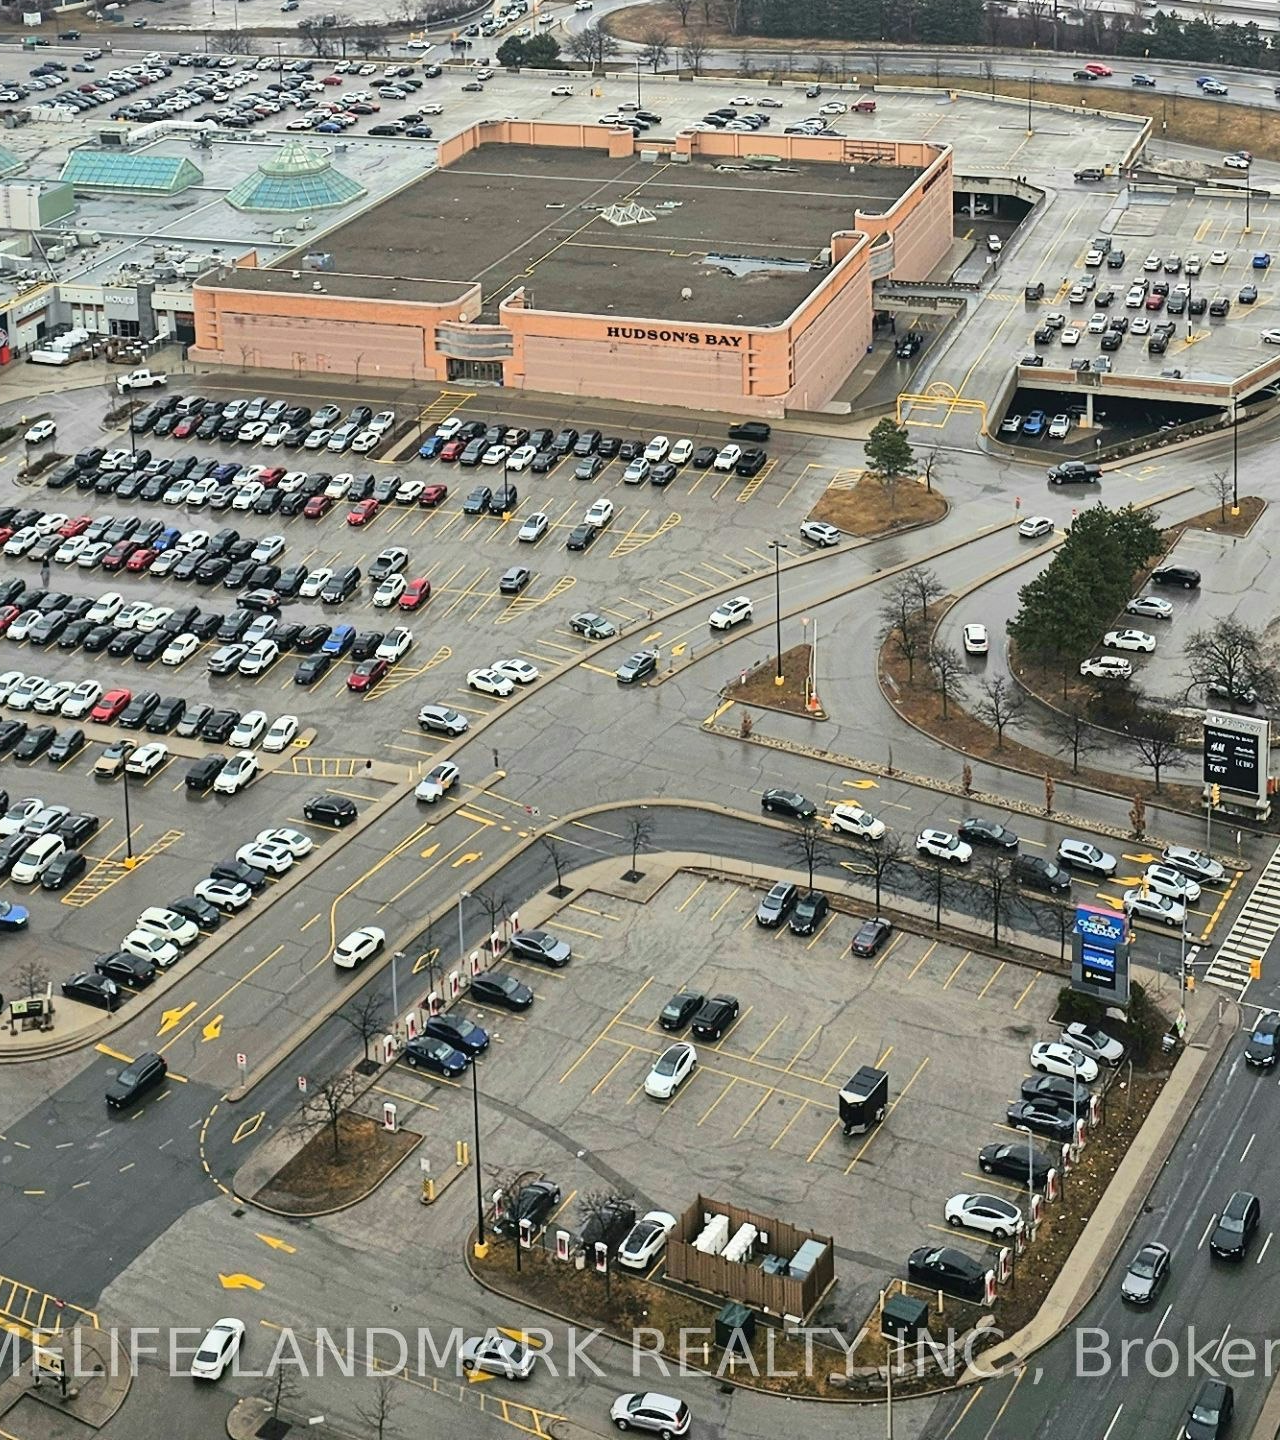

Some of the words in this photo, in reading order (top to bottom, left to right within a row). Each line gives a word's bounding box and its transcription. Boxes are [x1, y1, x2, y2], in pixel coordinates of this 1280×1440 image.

[607, 326, 700, 344] HUDSON'S
[705, 334, 742, 348] BAY
[1208, 763, 1227, 774] T&T
[1078, 919, 1121, 936] CINEPLEX
